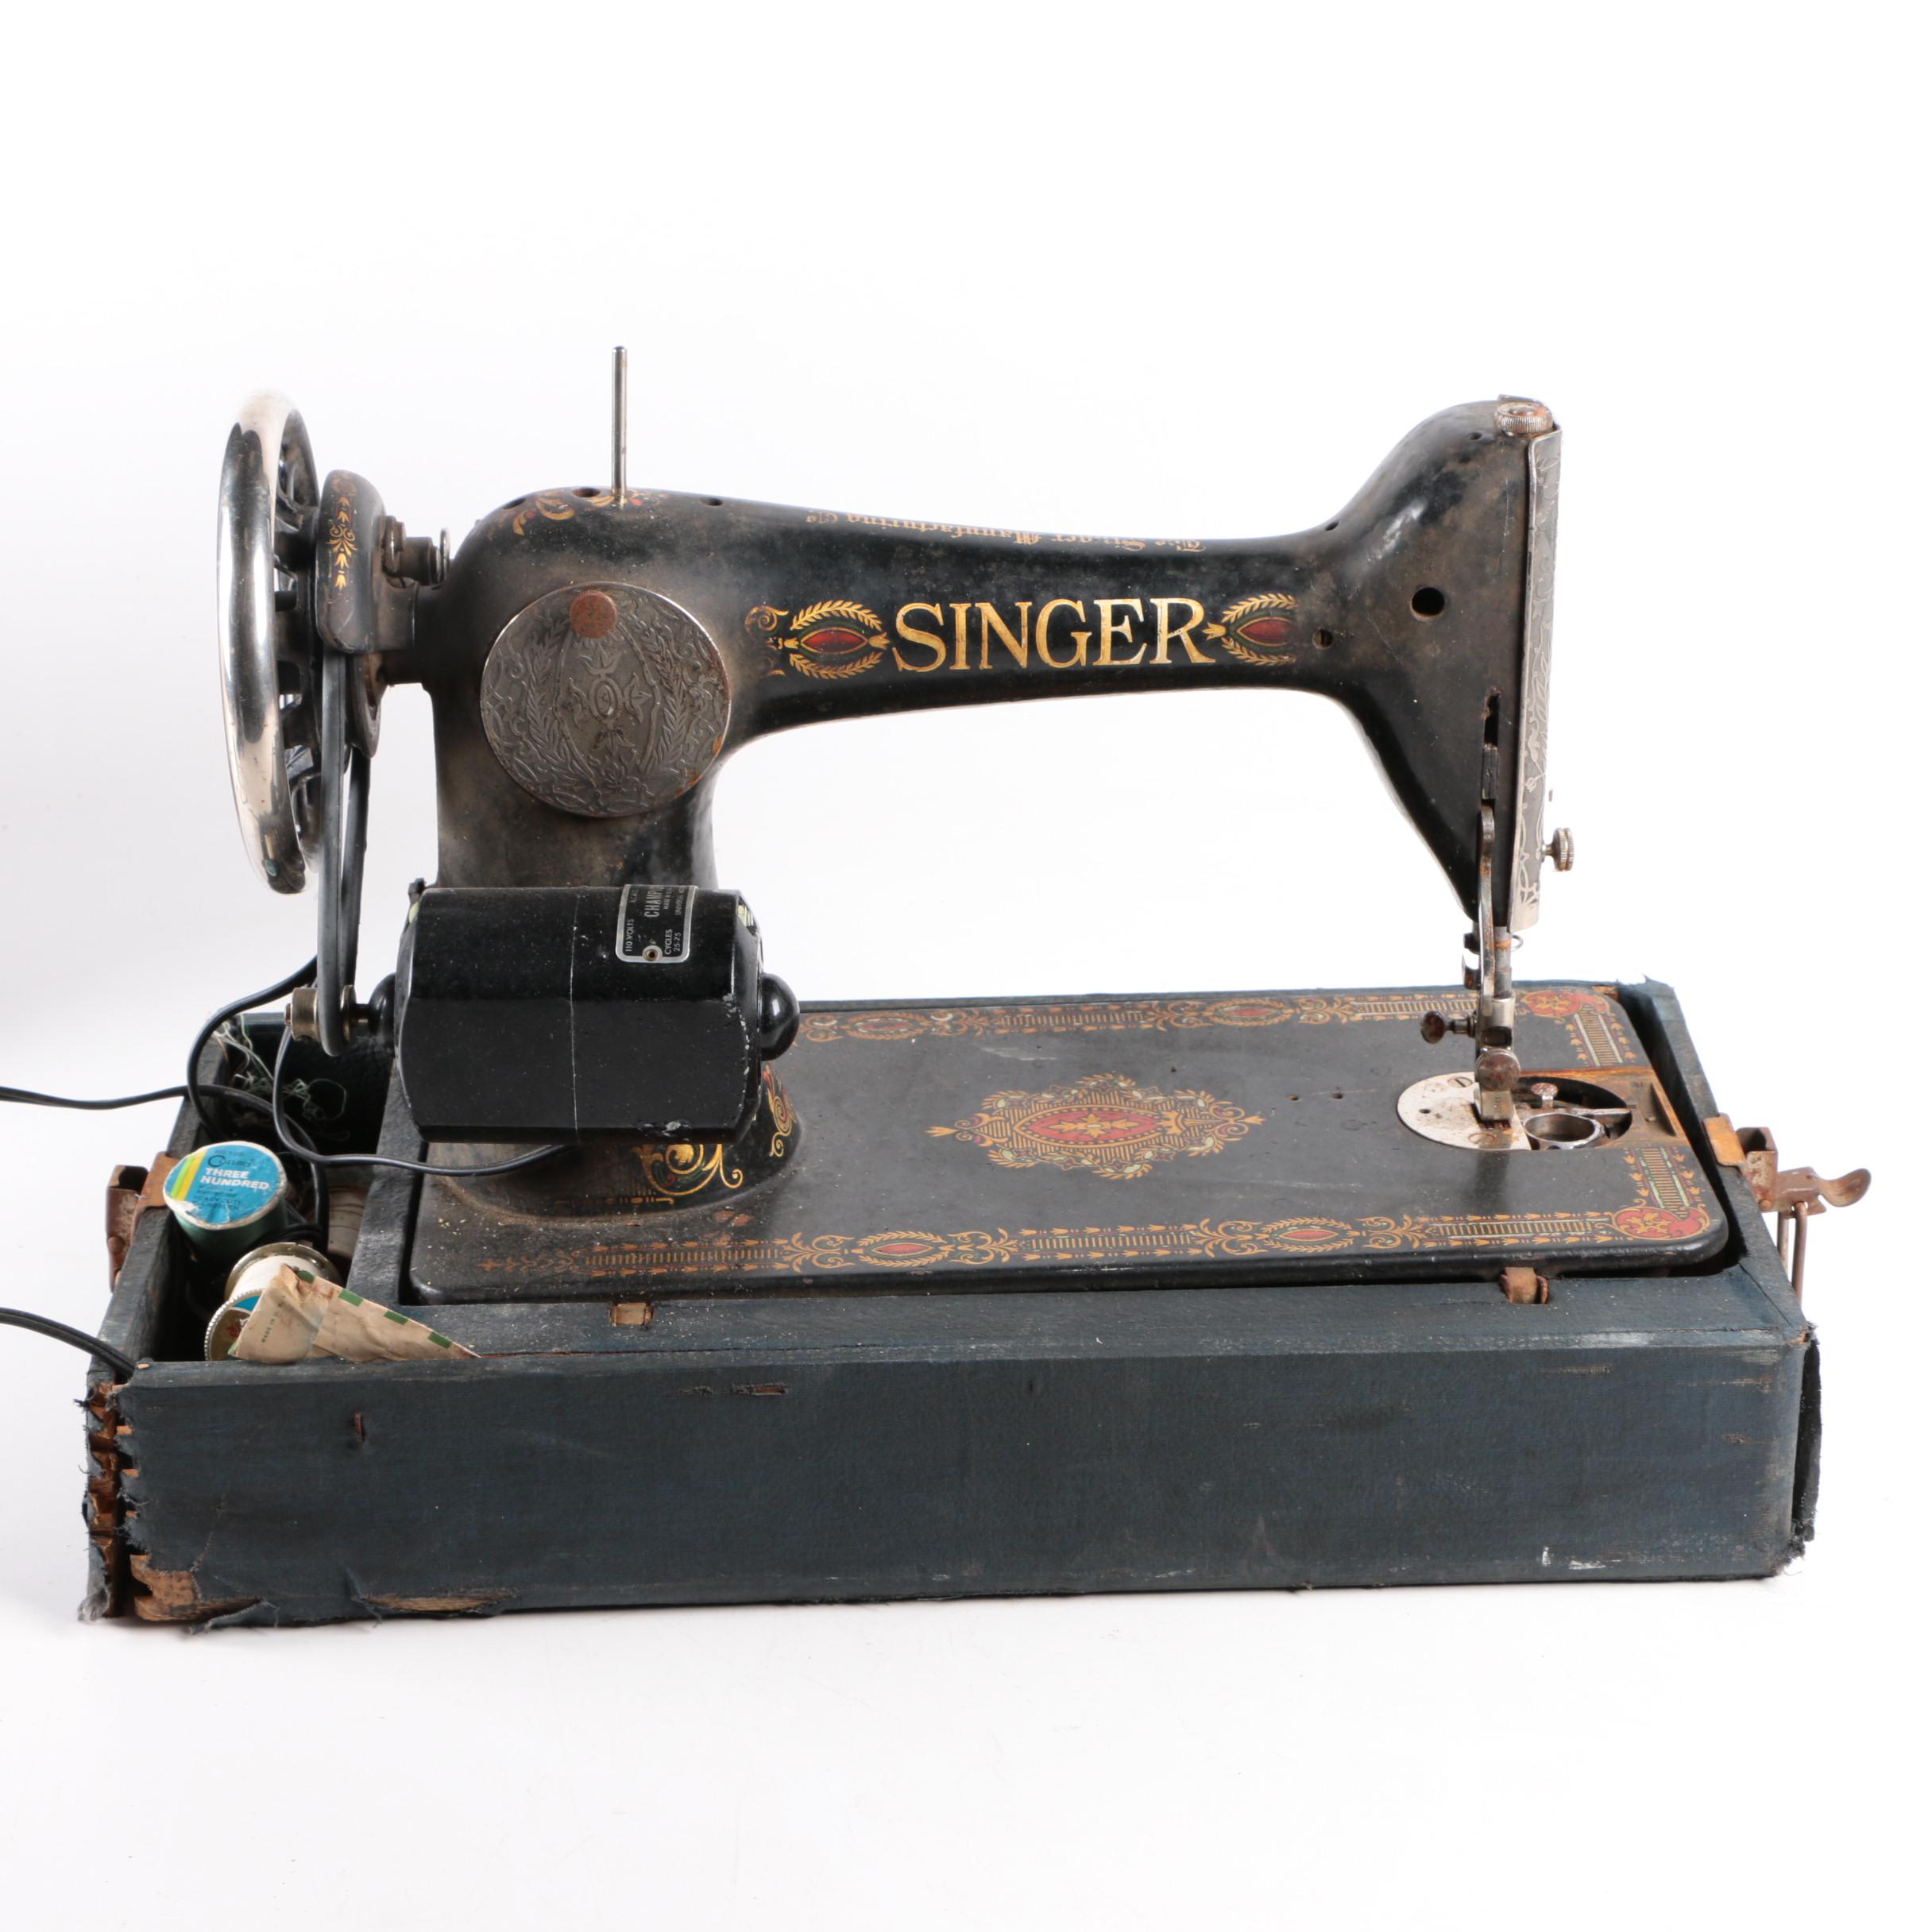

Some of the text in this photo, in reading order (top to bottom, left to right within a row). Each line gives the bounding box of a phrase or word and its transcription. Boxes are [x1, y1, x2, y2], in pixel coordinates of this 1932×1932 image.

[891, 598, 1216, 672] SINGER
[626, 918, 635, 941] VOLTS
[664, 929, 673, 955] CYCLES
[200, 1176, 270, 1190] HUNDRED
[205, 1167, 249, 1179] THREE
